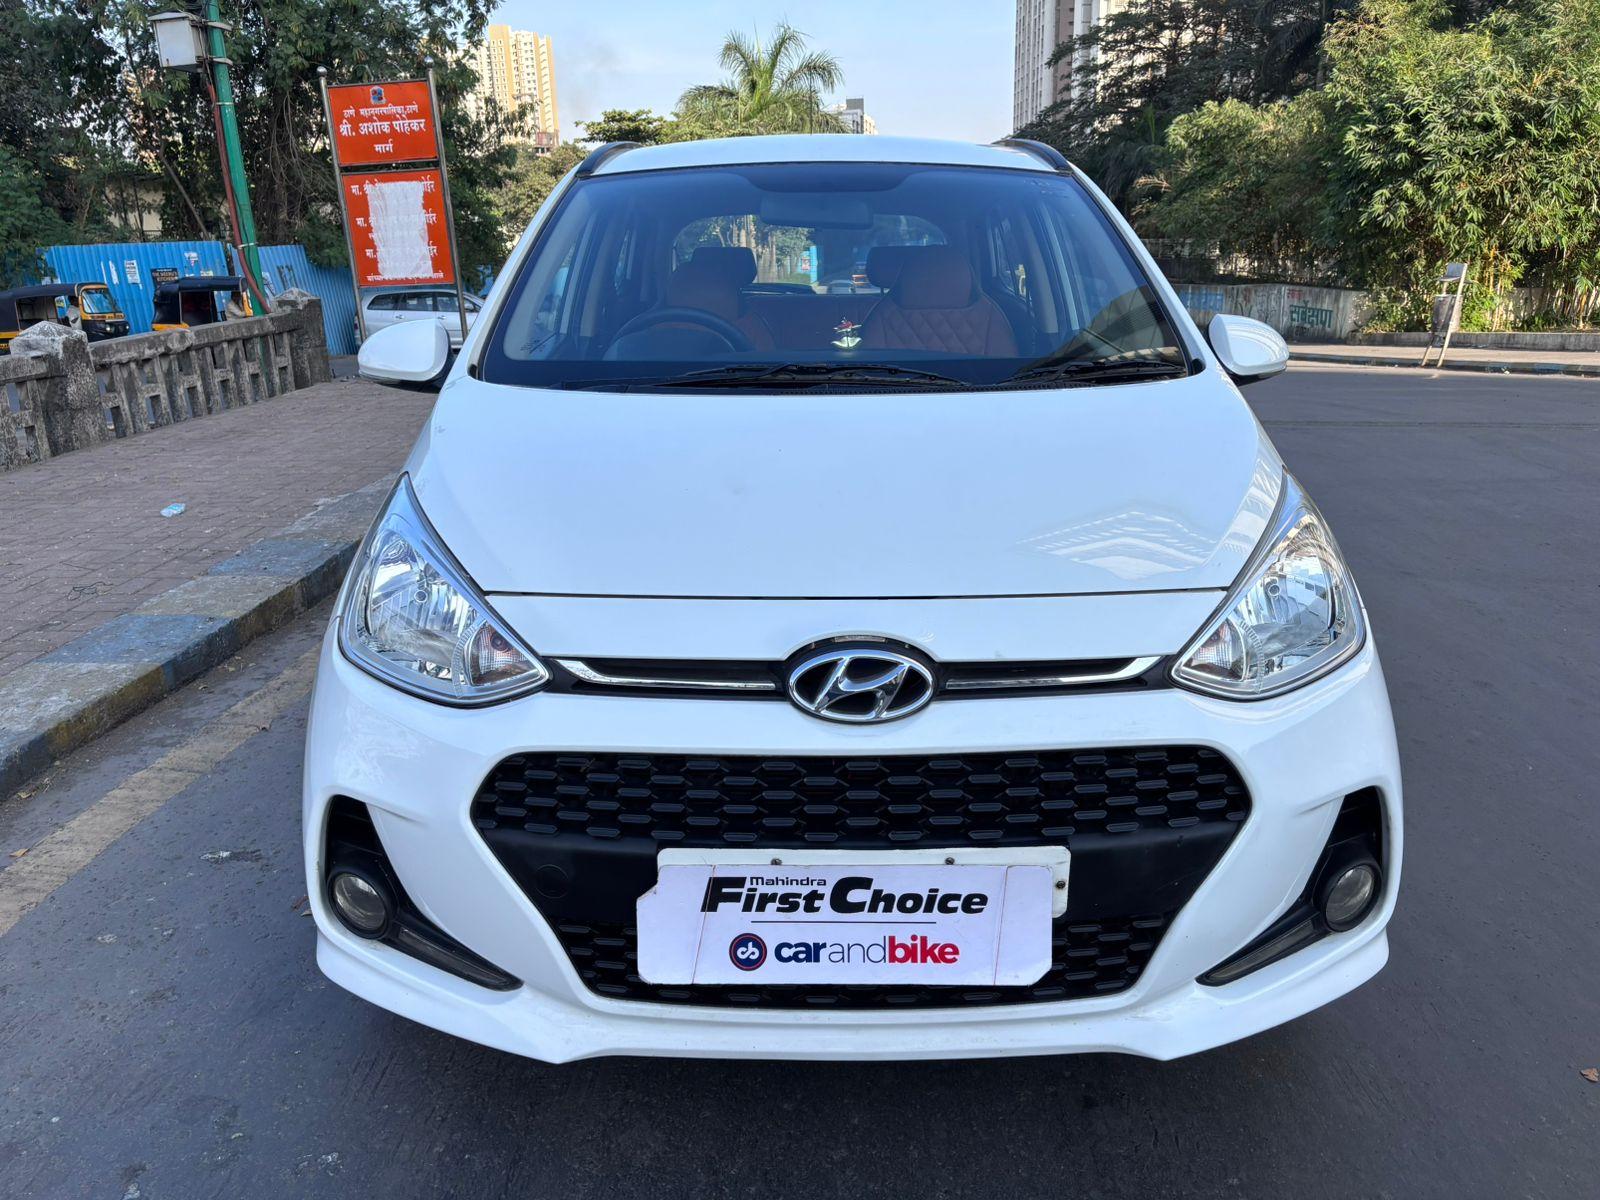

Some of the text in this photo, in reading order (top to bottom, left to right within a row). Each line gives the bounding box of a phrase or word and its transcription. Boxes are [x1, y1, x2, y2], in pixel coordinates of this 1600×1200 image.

[340, 114, 426, 136] श्री. अशोक पोहेकर
[374, 138, 393, 154] मार्ग
[749, 876, 827, 886] Mahindra
[700, 876, 989, 915] First Choice
[774, 934, 960, 964] carandbike
